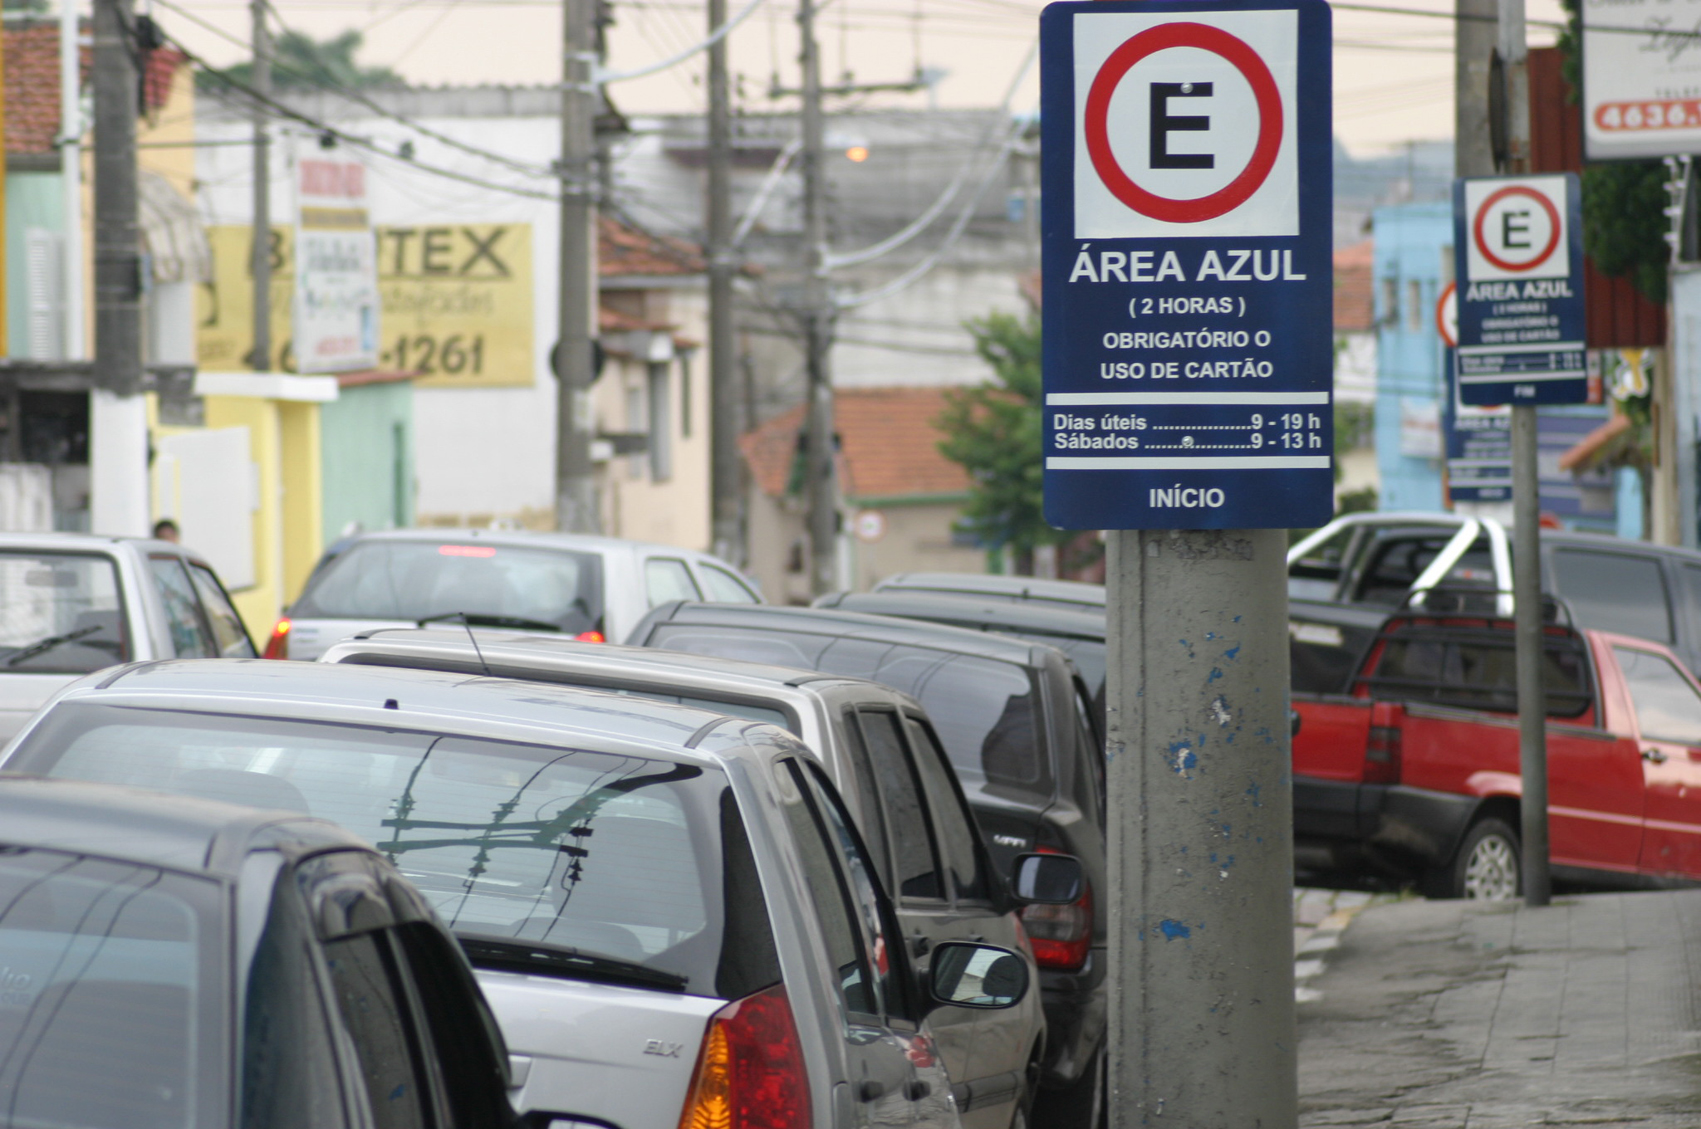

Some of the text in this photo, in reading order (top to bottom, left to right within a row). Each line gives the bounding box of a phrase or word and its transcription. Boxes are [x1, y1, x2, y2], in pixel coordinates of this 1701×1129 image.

[1149, 82, 1215, 169] E
[1602, 103, 1701, 128] 4636.
[1502, 211, 1531, 249] E
[1069, 243, 1307, 283] ÁREA AZUL
[1523, 281, 1574, 299] AZUL
[1158, 297, 1233, 314] HORAS
[1103, 327, 1271, 349] OBRIGATÓRIO O
[1100, 358, 1273, 379] USO DE CARTÃO
[1053, 413, 1095, 430] Dias
[1101, 413, 1147, 430] úteis
[1054, 433, 1139, 449] Sábados
[1149, 483, 1225, 508] INÍCIO
[643, 1039, 684, 1058] ELX
